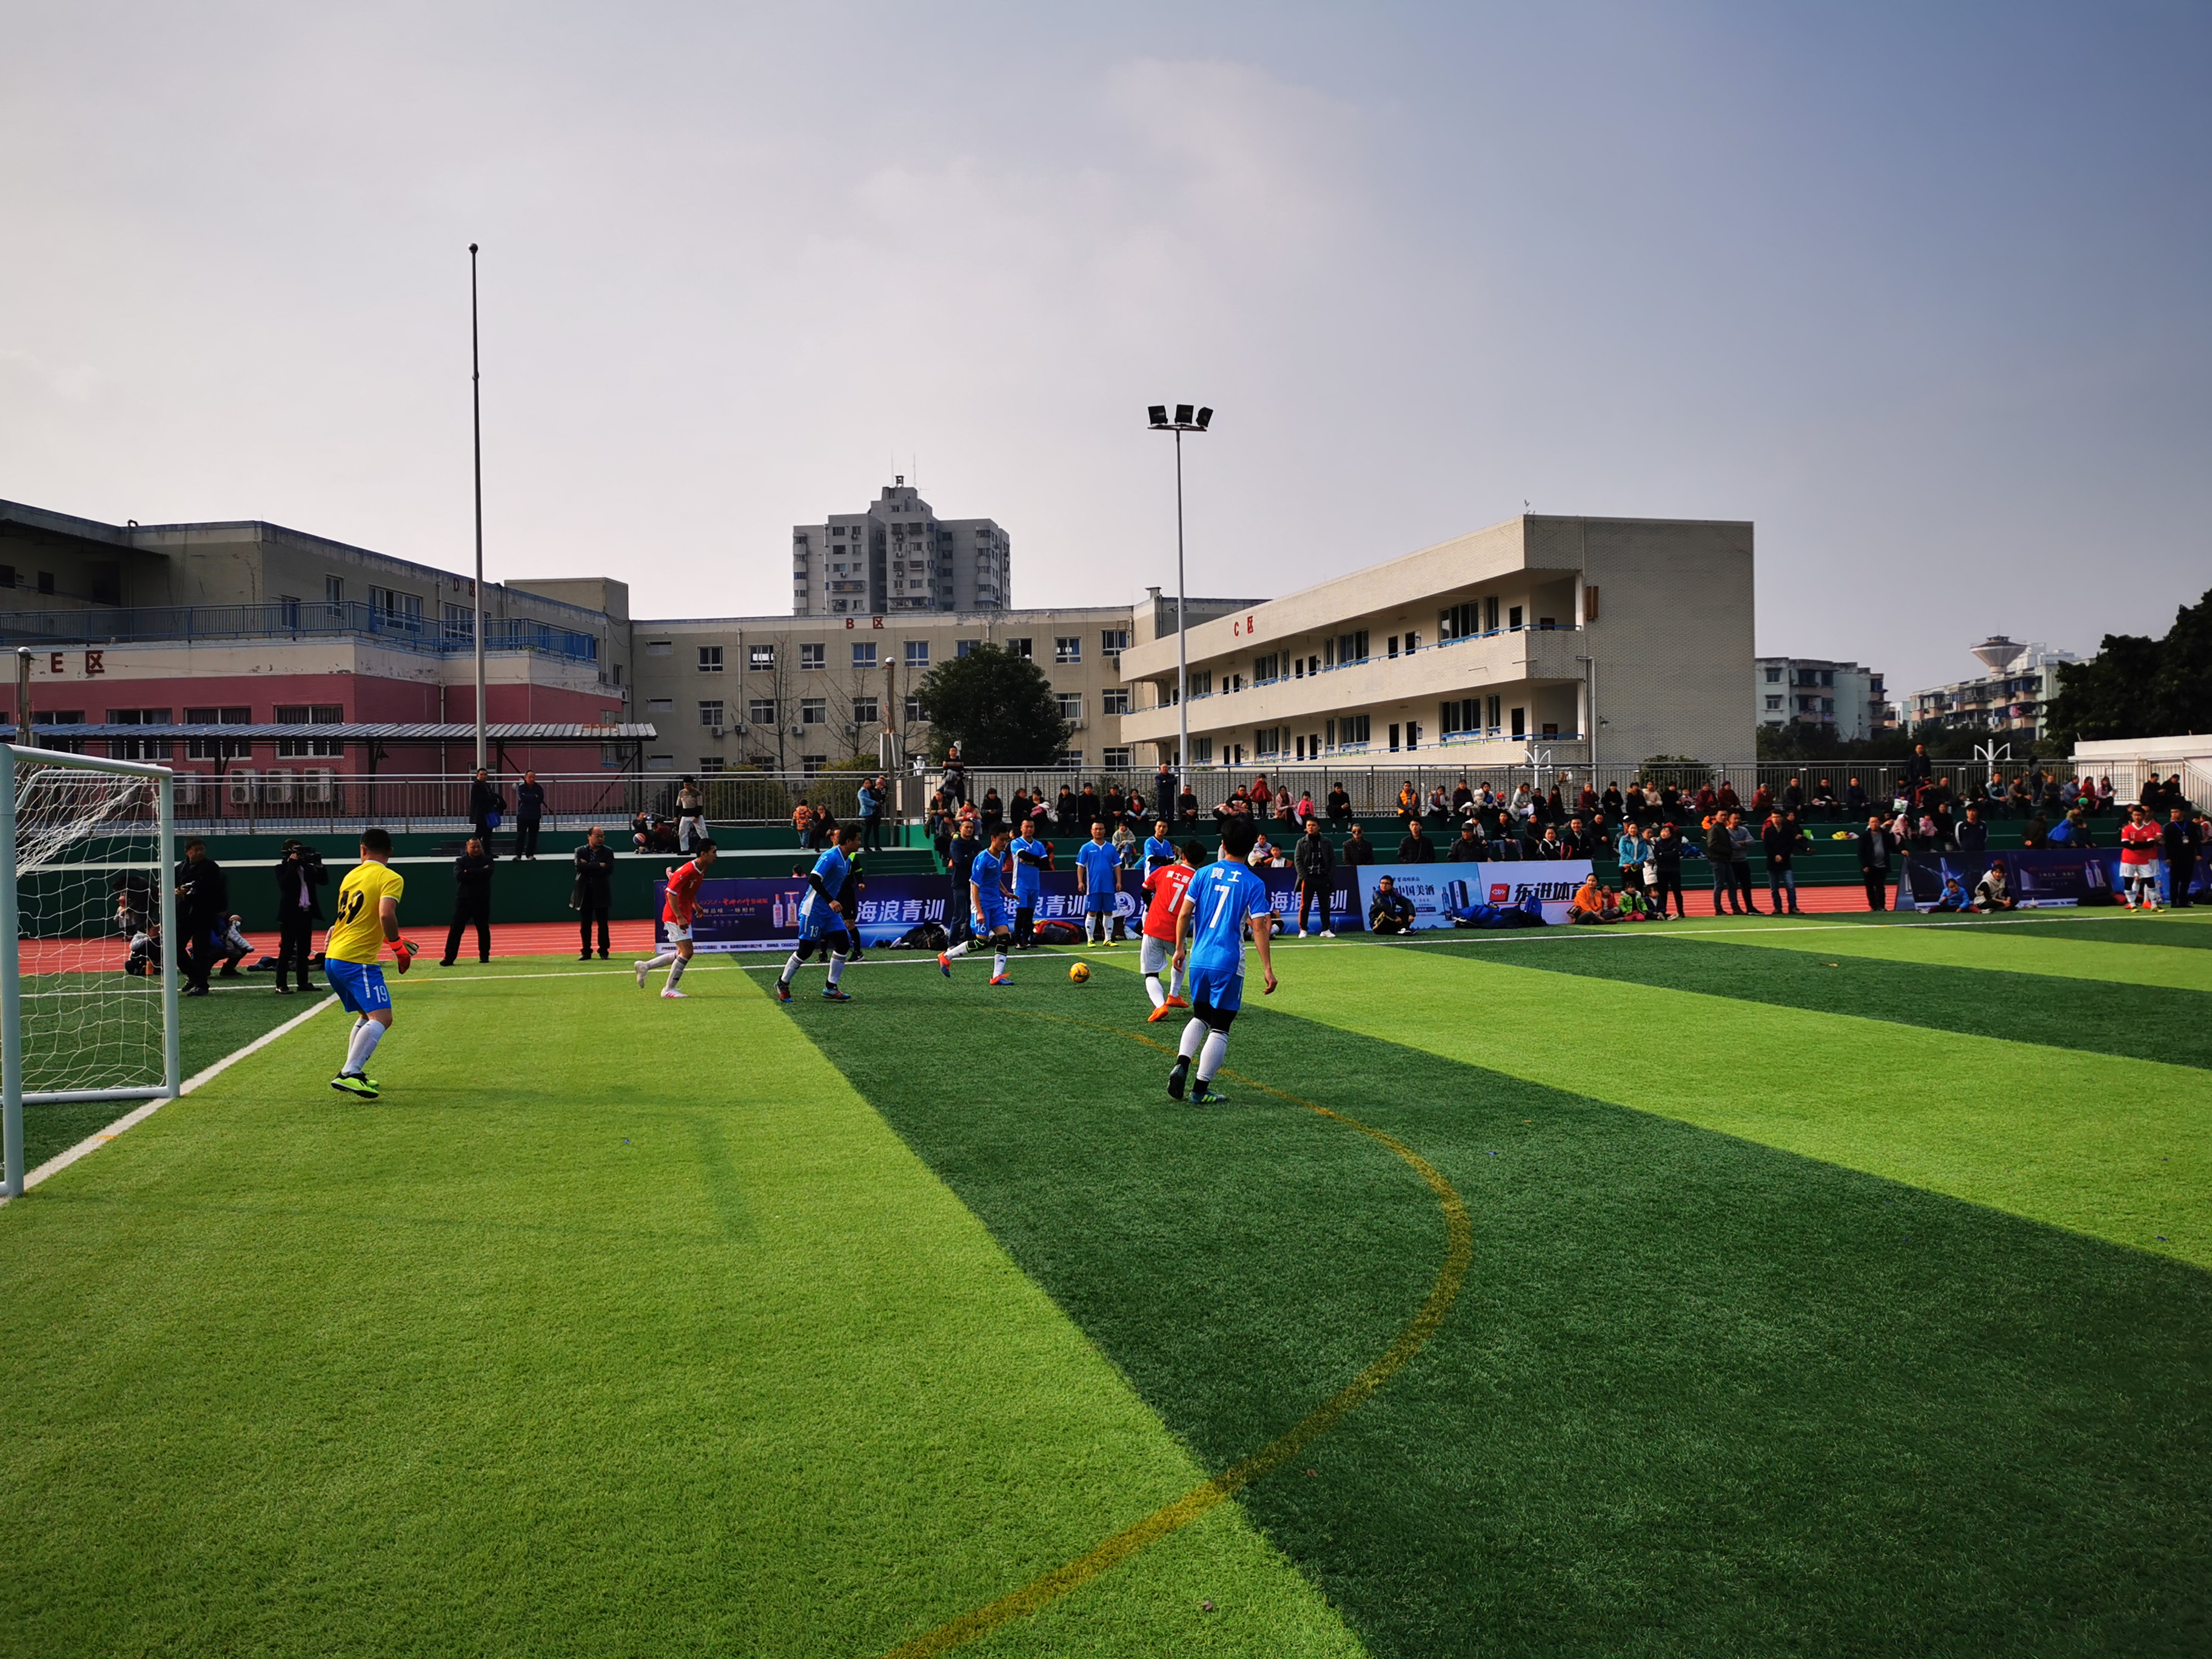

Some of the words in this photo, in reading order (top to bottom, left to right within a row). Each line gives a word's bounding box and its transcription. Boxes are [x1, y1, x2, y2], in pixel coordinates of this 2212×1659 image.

[1168, 882, 1185, 913] 7
[1209, 884, 1230, 928] 7
[855, 899, 945, 922] 海浪青训
[809, 925, 819, 937] 13
[977, 923, 986, 933] 16
[373, 985, 388, 1004] 19
